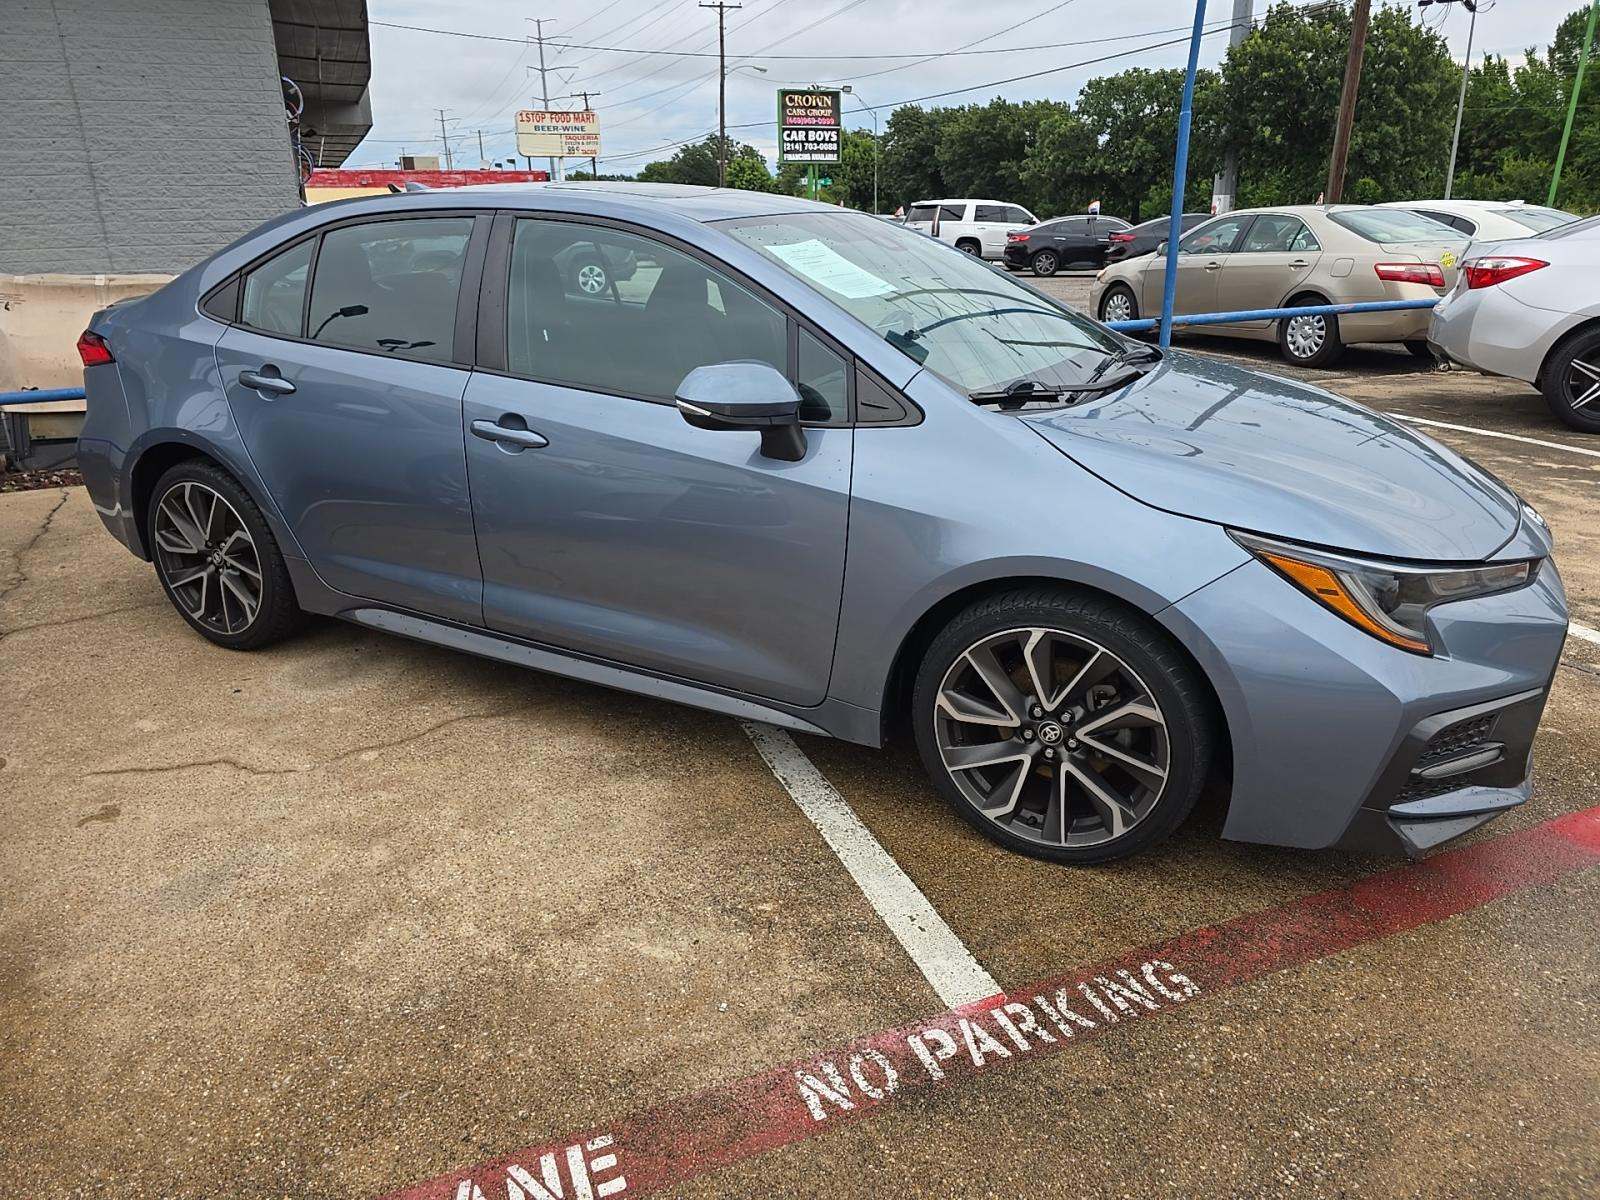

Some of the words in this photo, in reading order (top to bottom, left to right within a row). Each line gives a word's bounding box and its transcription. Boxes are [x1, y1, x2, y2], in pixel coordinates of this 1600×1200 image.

[785, 94, 832, 106] CROWN
[786, 108, 806, 116] CARS
[550, 113, 571, 123] FOOD
[573, 113, 596, 123] MART
[783, 130, 806, 141] CAR
[808, 130, 838, 141] BOYS
[784, 142, 803, 152] (214)
[795, 1047, 898, 1122] NO
[907, 959, 1202, 1081] PARKING
